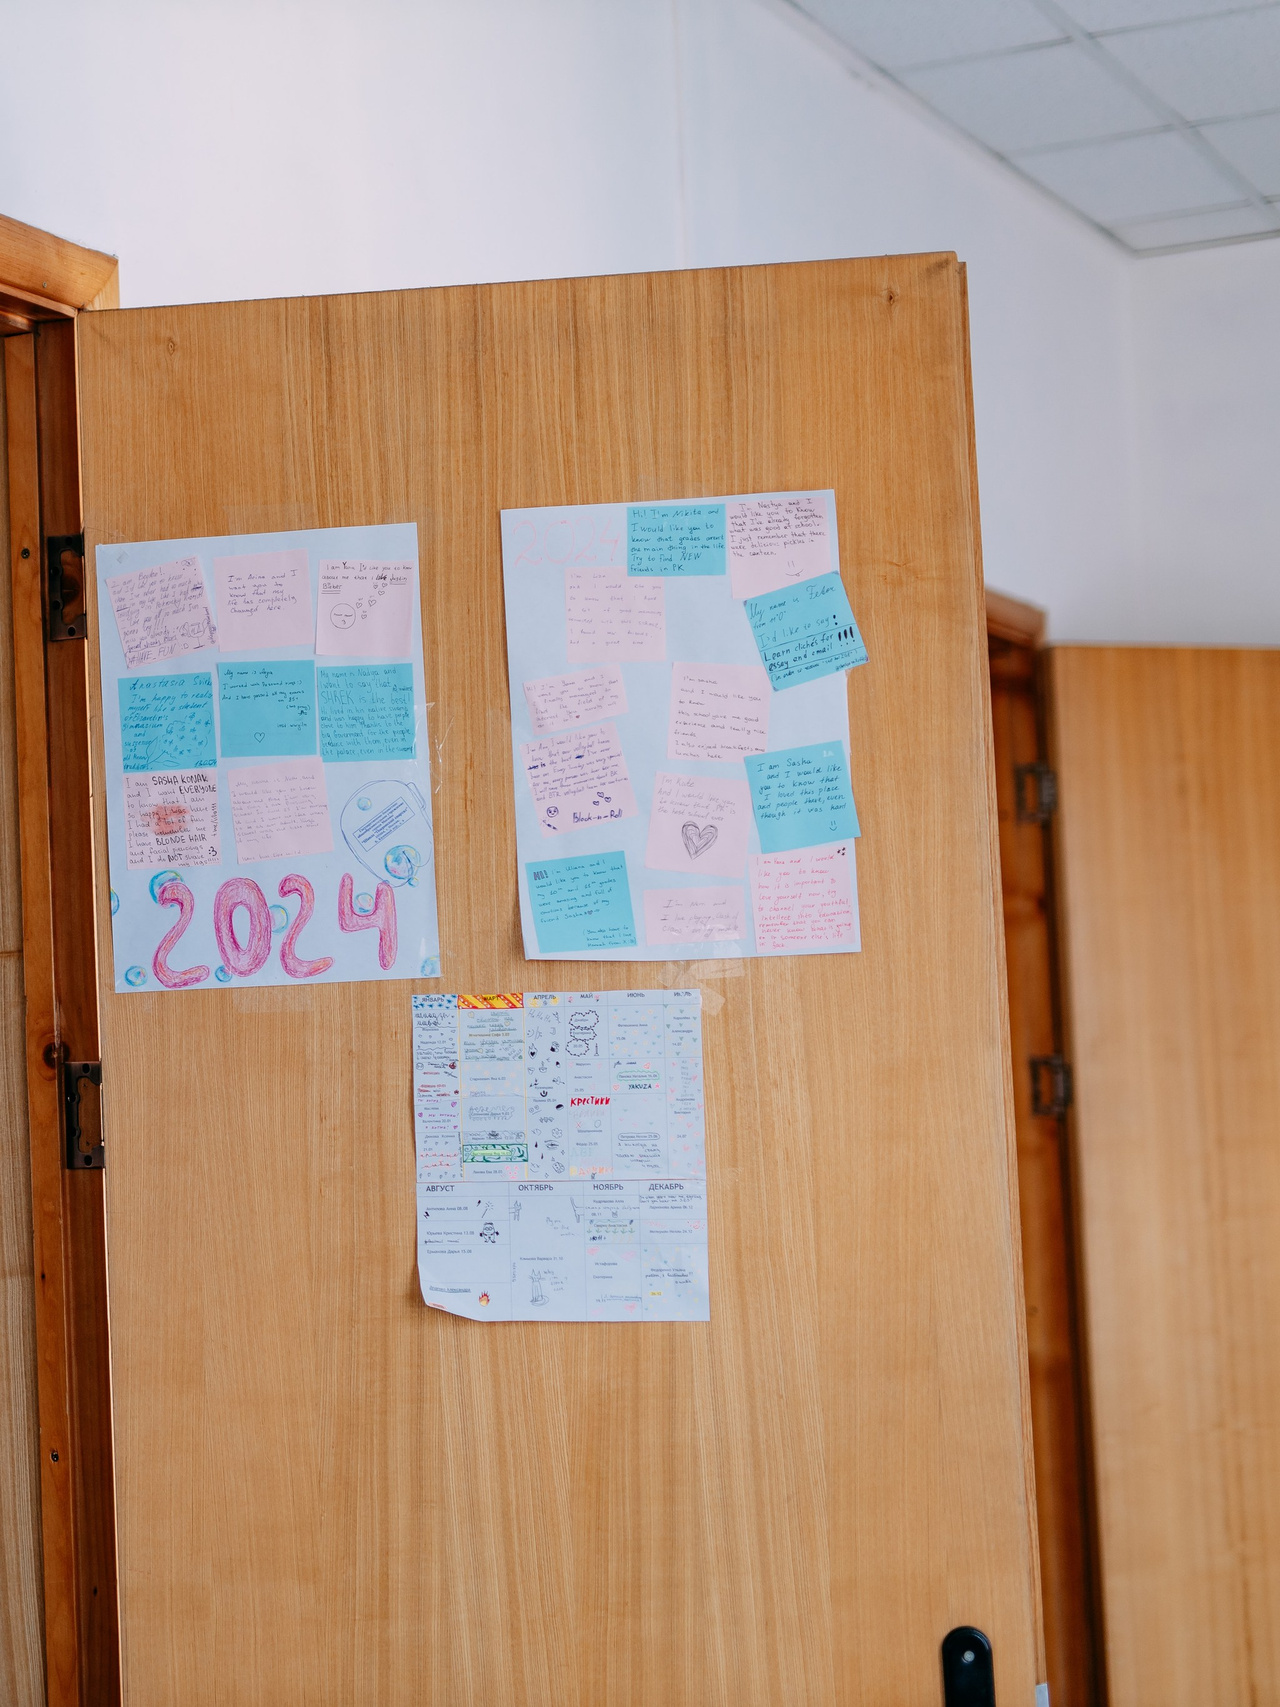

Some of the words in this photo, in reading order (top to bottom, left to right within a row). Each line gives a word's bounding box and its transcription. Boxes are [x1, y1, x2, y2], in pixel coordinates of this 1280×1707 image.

[641, 524, 663, 532] would
[679, 536, 700, 545] grades
[680, 553, 701, 561] NEW
[764, 649, 790, 662] Learn
[822, 633, 833, 644] for
[769, 660, 789, 672] essay
[812, 642, 833, 656] email
[359, 682, 372, 693] say
[320, 690, 354, 705] SHREK
[786, 758, 812, 767] Sasha
[767, 772, 779, 780] and
[827, 764, 842, 772] like
[152, 775, 179, 786] SASHA
[820, 775, 839, 783] that
[145, 787, 151, 797] I
[179, 784, 217, 794] EVERYONE
[819, 786, 839, 795] place
[139, 800, 158, 808] know
[162, 797, 180, 805] that
[776, 800, 798, 811] people
[140, 810, 159, 820] happy
[760, 810, 786, 820] though
[129, 831, 148, 841] please
[155, 836, 186, 846] BLONDE
[189, 833, 207, 842] HAIR
[167, 854, 182, 862] NOT
[152, 872, 398, 989] 2024
[518, 1184, 554, 1192] ОКТЯБРЬ
[649, 1183, 684, 1191] ДЕКАБРЬ
